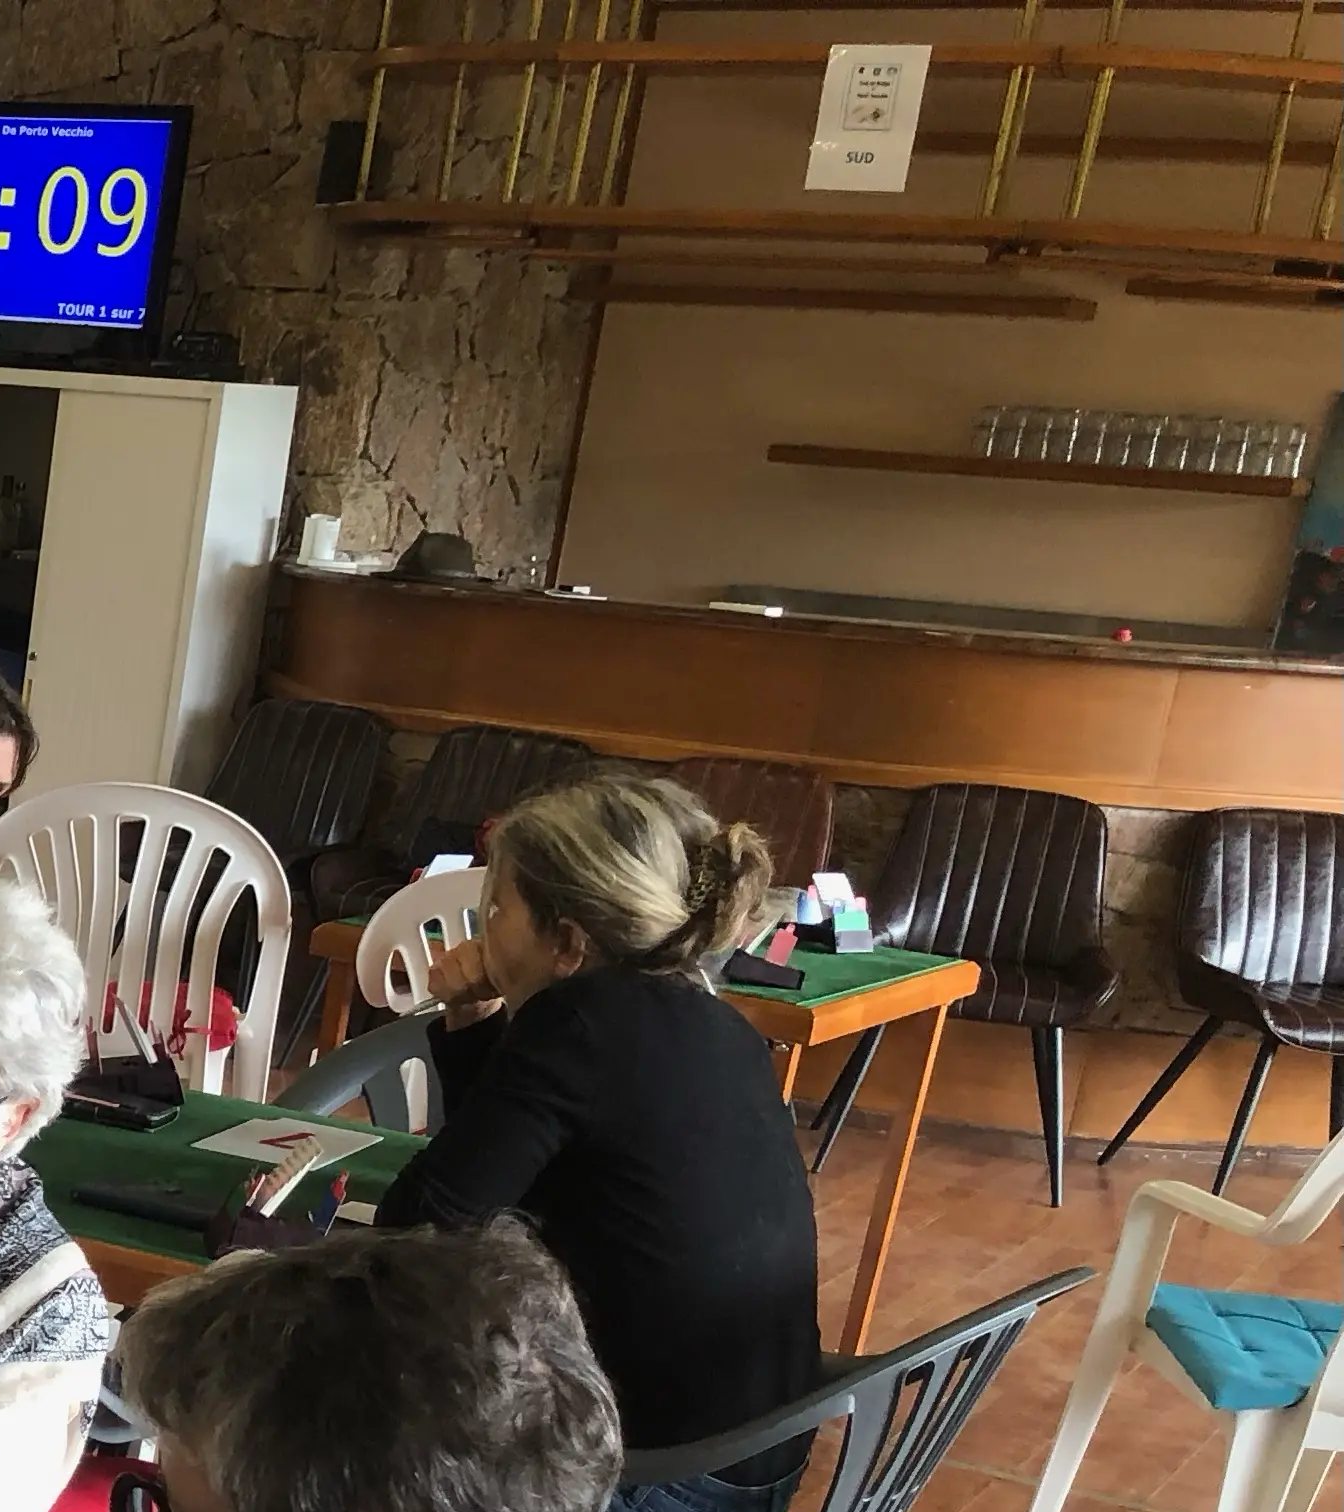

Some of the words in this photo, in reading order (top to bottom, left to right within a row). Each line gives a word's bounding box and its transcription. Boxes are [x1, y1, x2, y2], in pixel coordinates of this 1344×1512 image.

[19, 125, 48, 137] Porto
[51, 126, 94, 138] Vecchio
[846, 151, 874, 164] SUD
[57, 303, 95, 318] TOUR
[99, 306, 107, 318] 1
[111, 309, 135, 320] sur
